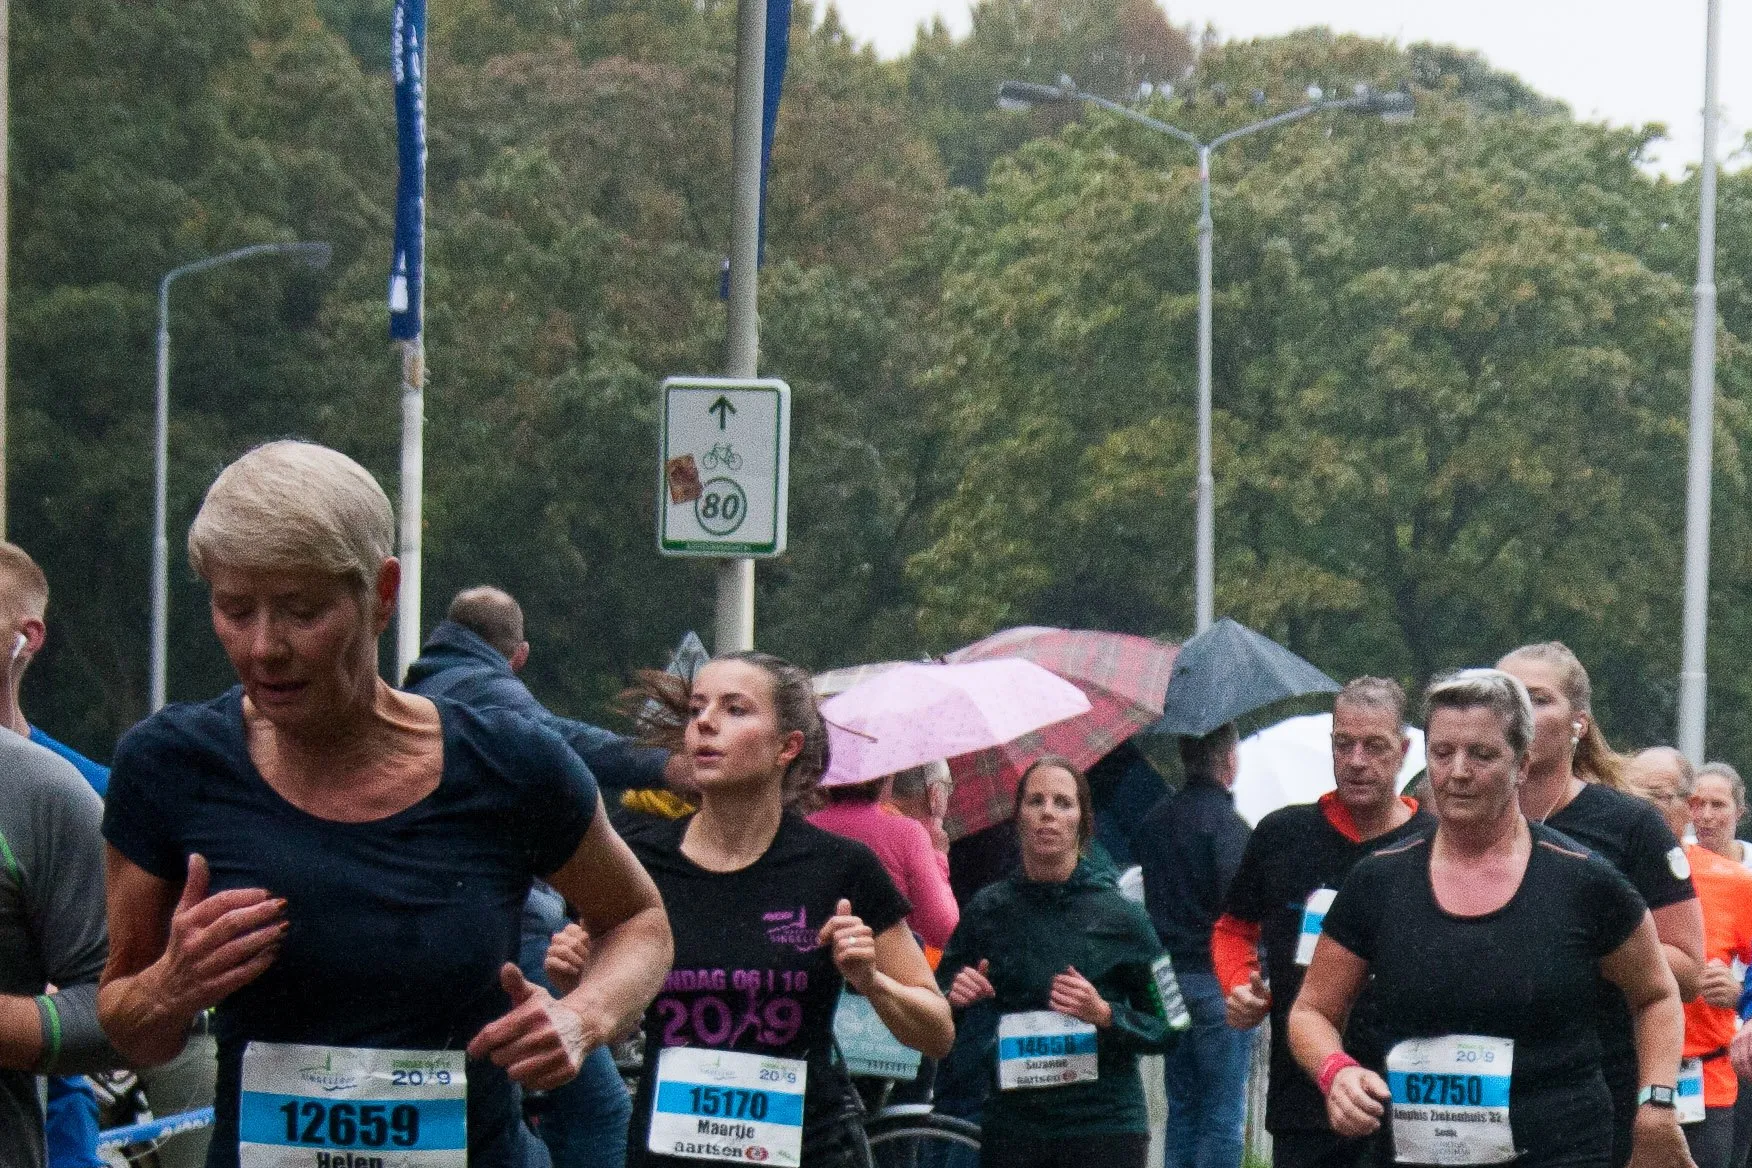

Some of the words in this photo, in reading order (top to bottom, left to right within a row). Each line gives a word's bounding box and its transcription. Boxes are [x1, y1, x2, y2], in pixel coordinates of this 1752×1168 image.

[702, 493, 739, 520] 80
[732, 967, 761, 992] 06
[781, 970, 809, 993] 10
[1405, 1073, 1482, 1106] 62750
[689, 1086, 768, 1121] 15170
[279, 1100, 420, 1147] 12659
[697, 1118, 756, 1140] Maartje
[674, 1139, 743, 1158] aartsen
